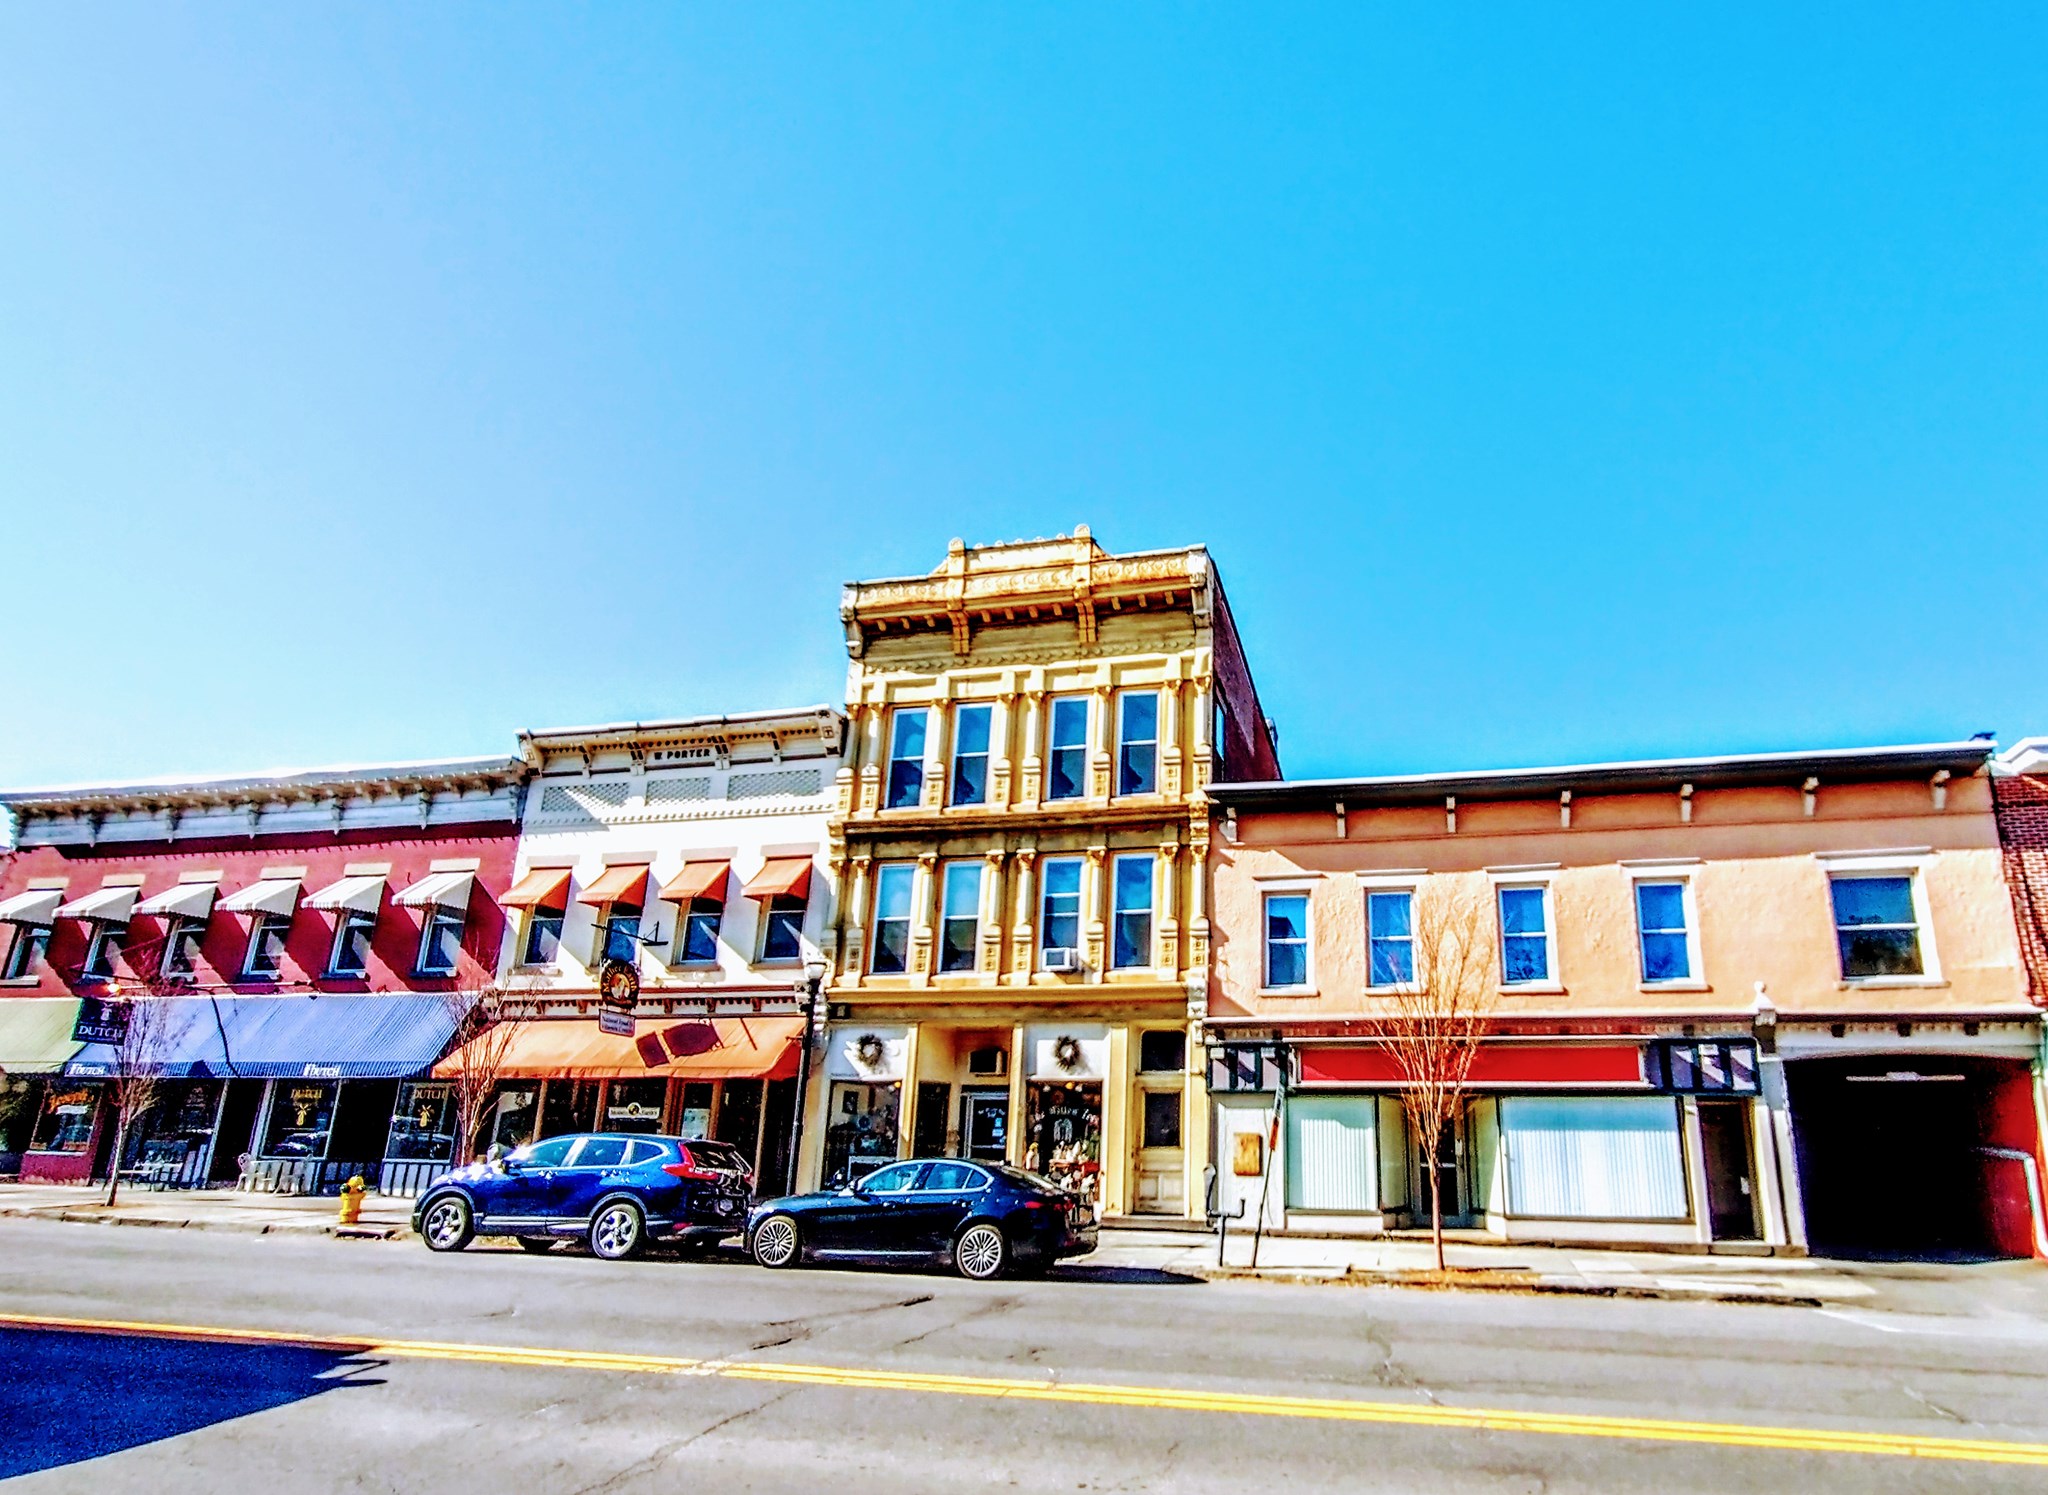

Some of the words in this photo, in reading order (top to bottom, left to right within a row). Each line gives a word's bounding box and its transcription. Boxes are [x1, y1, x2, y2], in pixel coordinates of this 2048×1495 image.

[667, 749, 710, 759] PORTER
[78, 1025, 124, 1038] DUTCH
[74, 1066, 105, 1075] DUTCH
[310, 1066, 341, 1077] DUTCH
[413, 1089, 447, 1100] DUTCH
